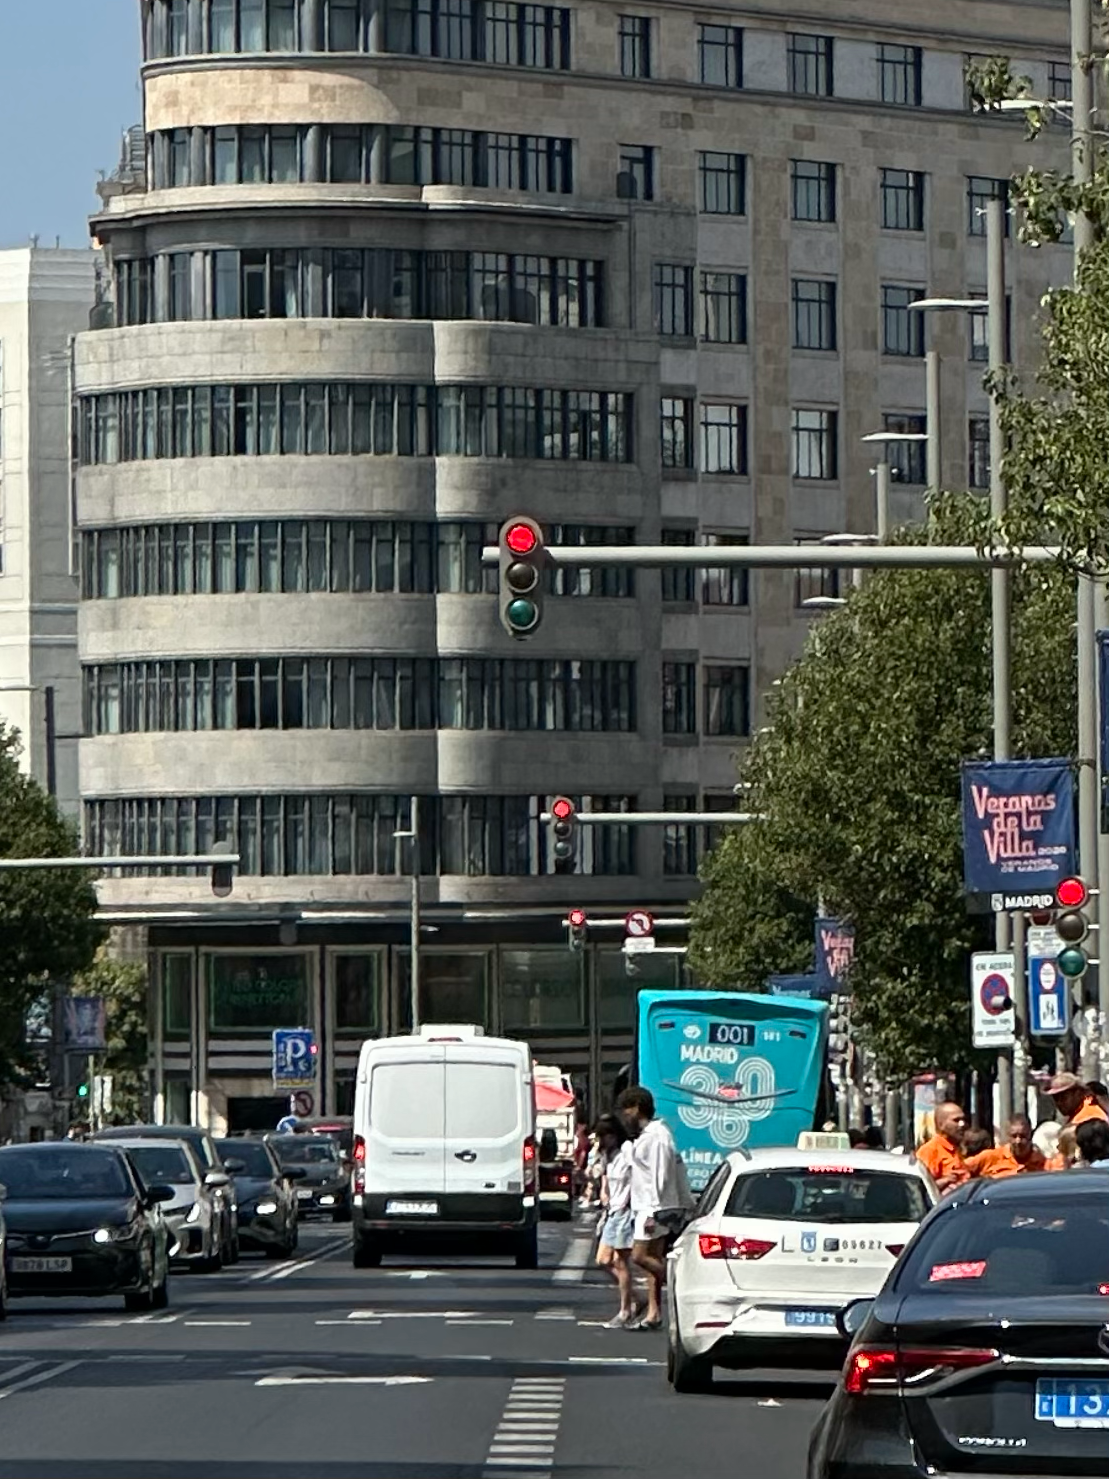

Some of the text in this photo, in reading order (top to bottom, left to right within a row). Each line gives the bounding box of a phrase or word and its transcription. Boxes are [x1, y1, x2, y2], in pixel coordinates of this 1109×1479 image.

[970, 783, 1057, 819] Veranos
[993, 811, 1018, 832] de
[982, 829, 1037, 864] Villa
[1005, 894, 1054, 909] MADRID
[716, 1024, 749, 1045] 001
[680, 1044, 739, 1064] MADRID
[1067, 1384, 1109, 1415] 13
